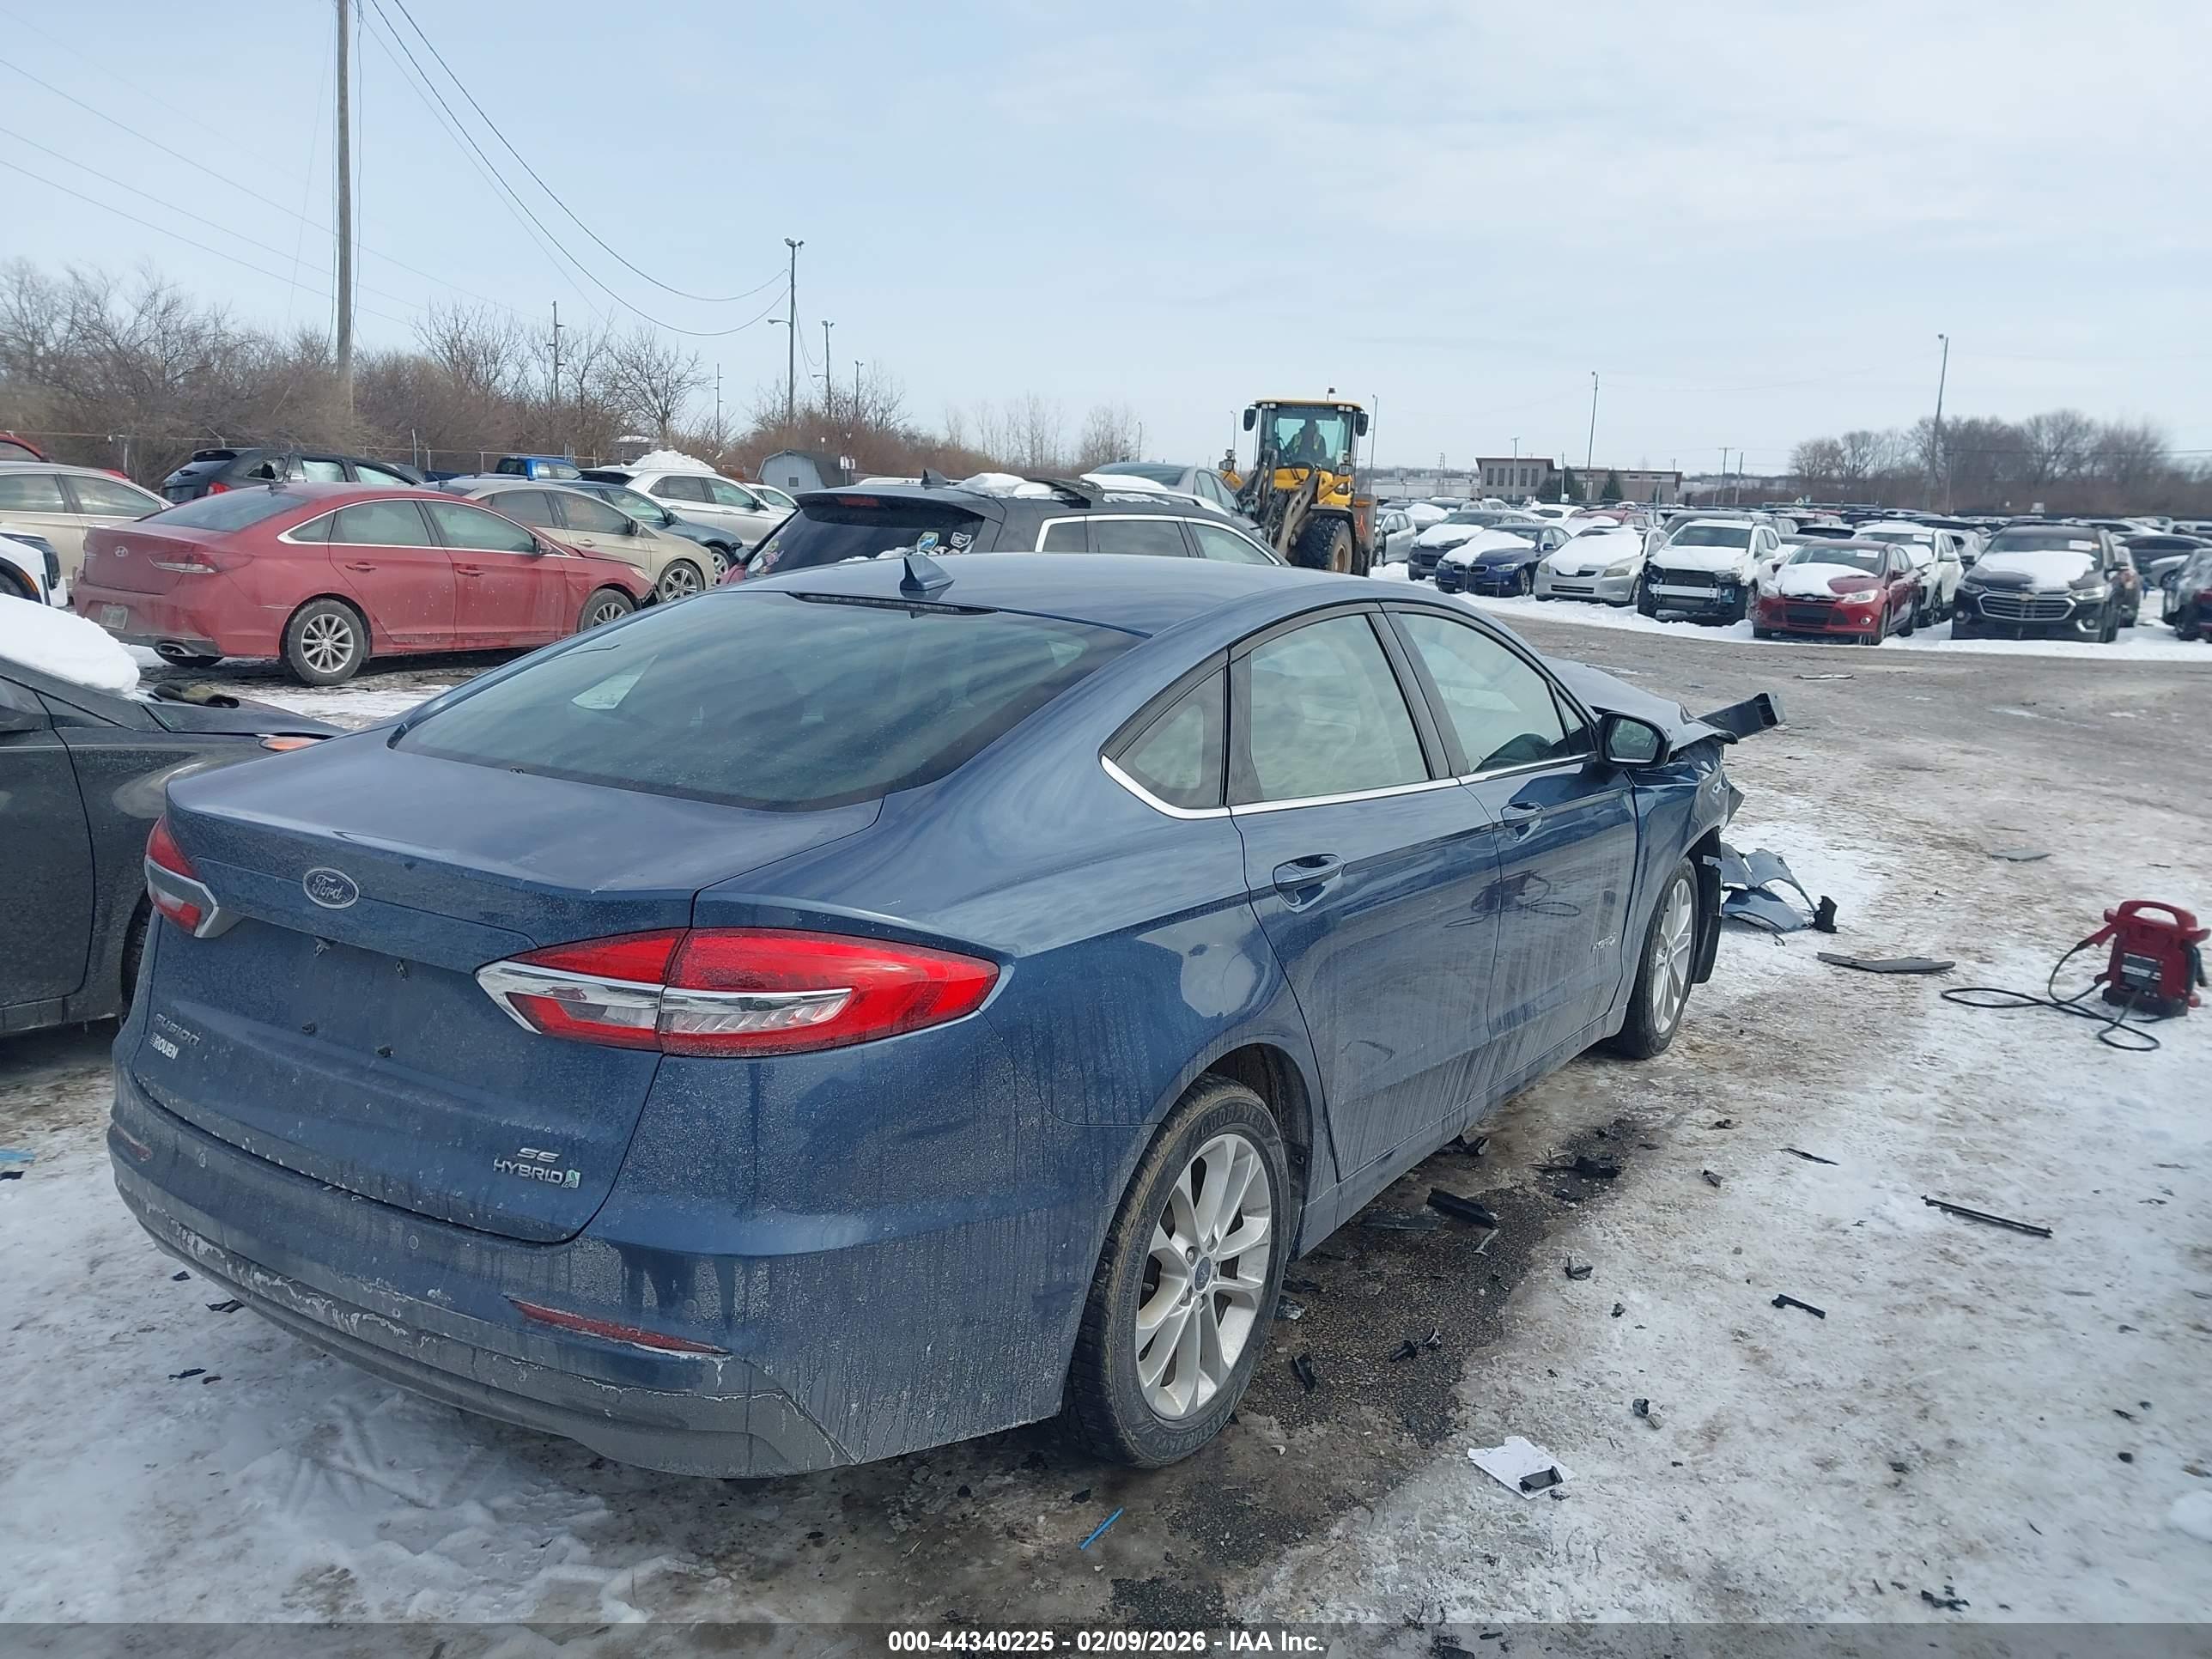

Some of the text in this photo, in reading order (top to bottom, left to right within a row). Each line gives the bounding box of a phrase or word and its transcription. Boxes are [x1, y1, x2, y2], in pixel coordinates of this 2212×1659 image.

[312, 874, 345, 901] Ford
[517, 1147, 560, 1163] SE
[493, 1158, 563, 1184] HYBRID
